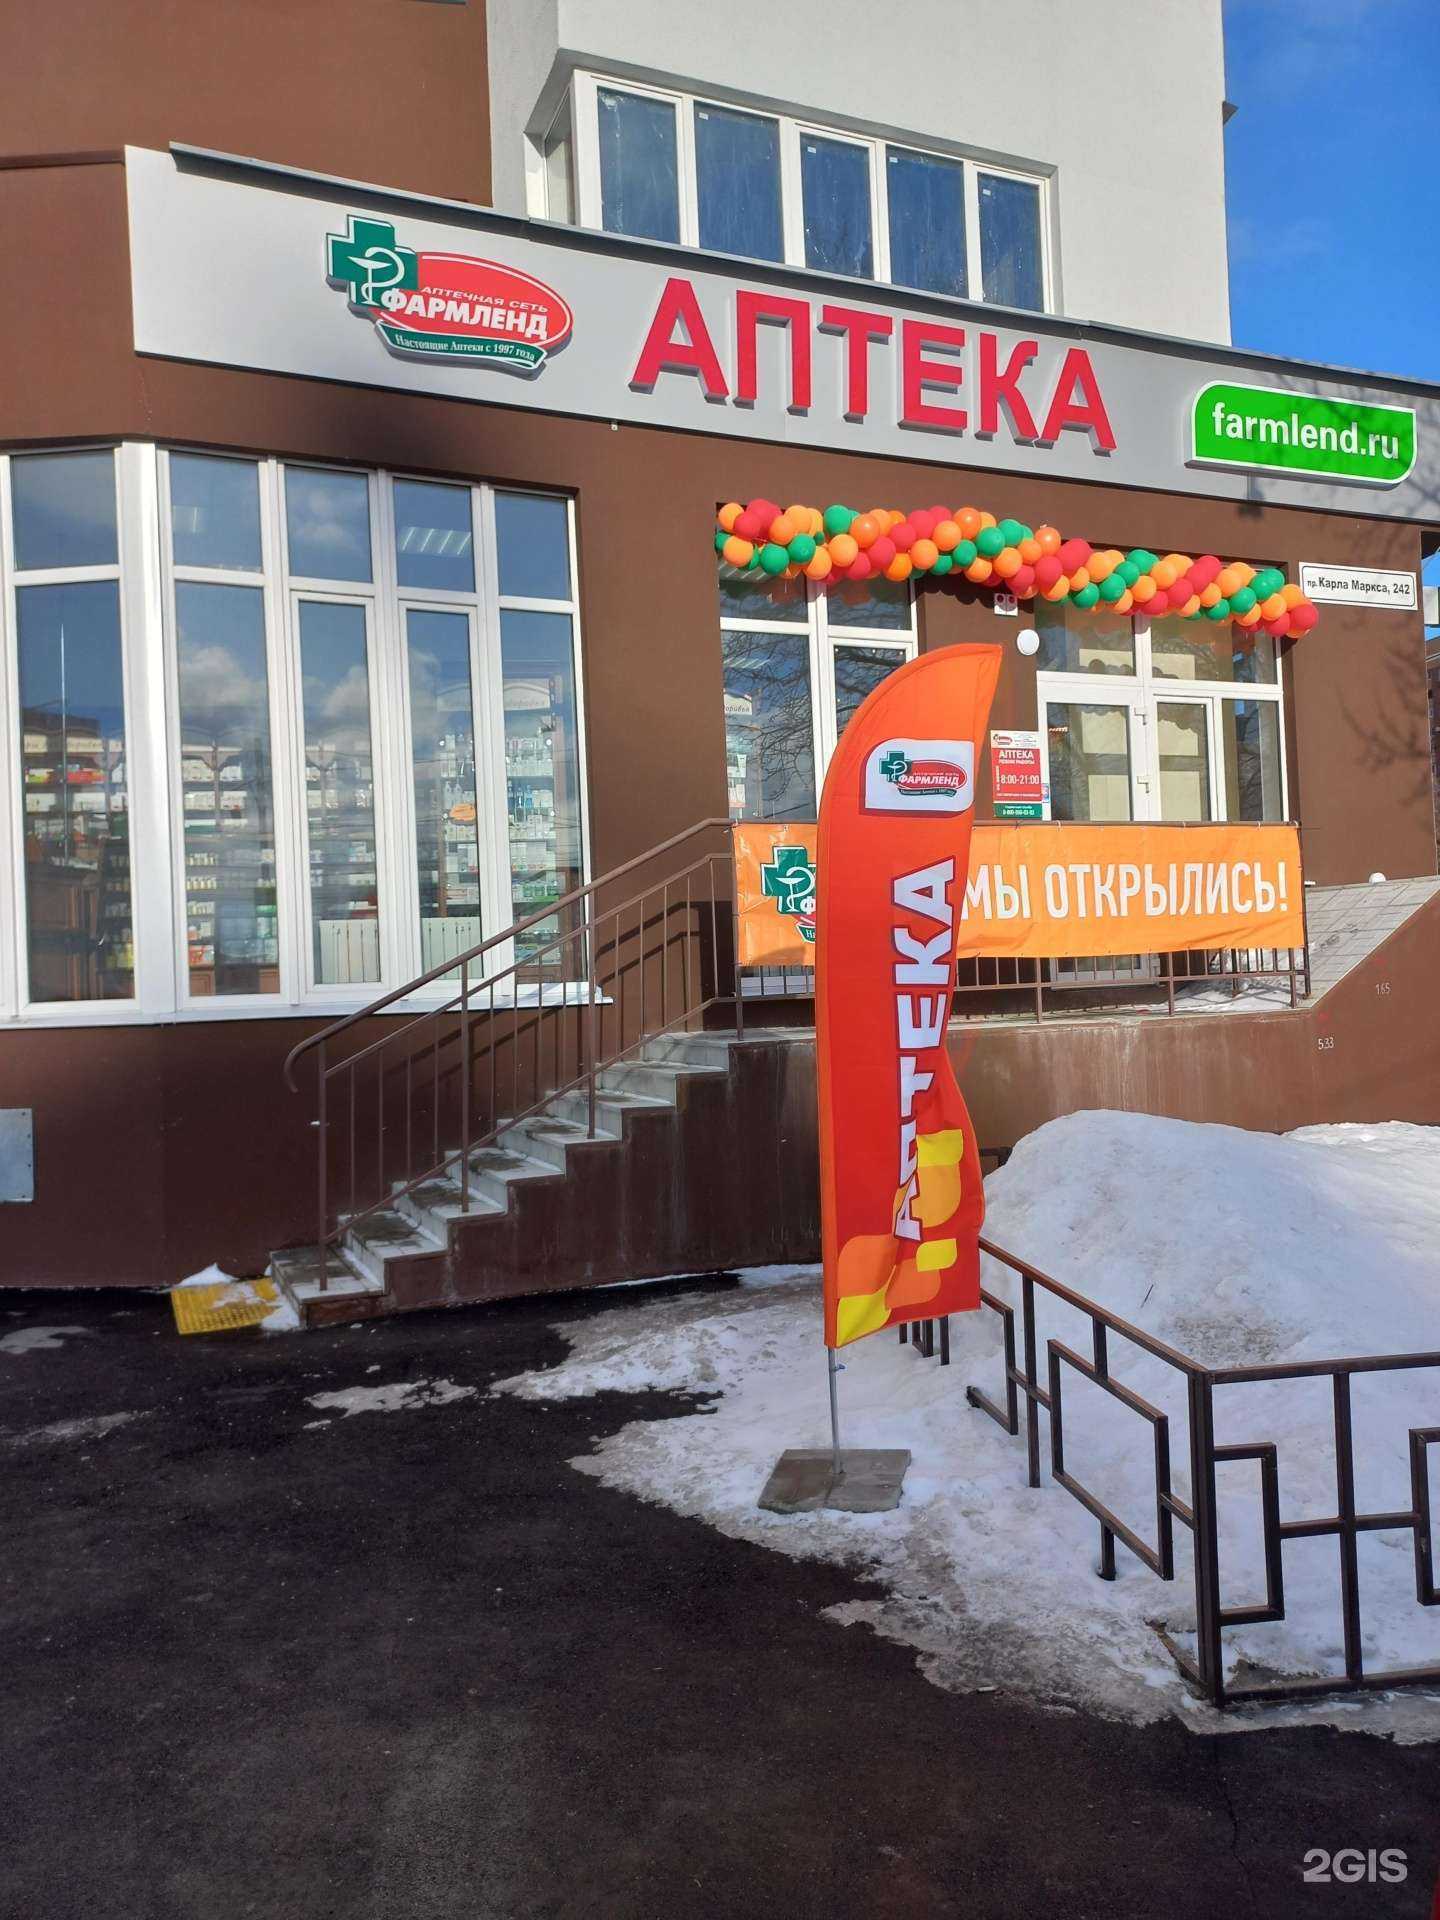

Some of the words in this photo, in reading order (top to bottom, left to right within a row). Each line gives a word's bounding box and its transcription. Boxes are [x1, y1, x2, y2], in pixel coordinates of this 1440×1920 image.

[422, 287, 504, 305] АПТЕЧНАЯ
[509, 300, 549, 313] СЕТЬ
[381, 288, 548, 340] ФАРМЛЕНД
[395, 334, 449, 351] Настоящие
[450, 342, 484, 352] Аптеки
[493, 343, 514, 355] 1997
[515, 348, 535, 361] года
[629, 277, 1117, 456] АПТЕКА
[1211, 402, 1399, 459] farmlend.ru
[1318, 576, 1349, 591] Карла
[1351, 579, 1390, 595] Маркса,
[1393, 583, 1411, 595] 242
[999, 750, 1034, 759] АПТЕКА
[898, 774, 959, 787] ФАРМЛЕНД
[962, 863, 1031, 920] МЫ
[1045, 861, 1288, 919] ОТКРЫЛИСЬ!
